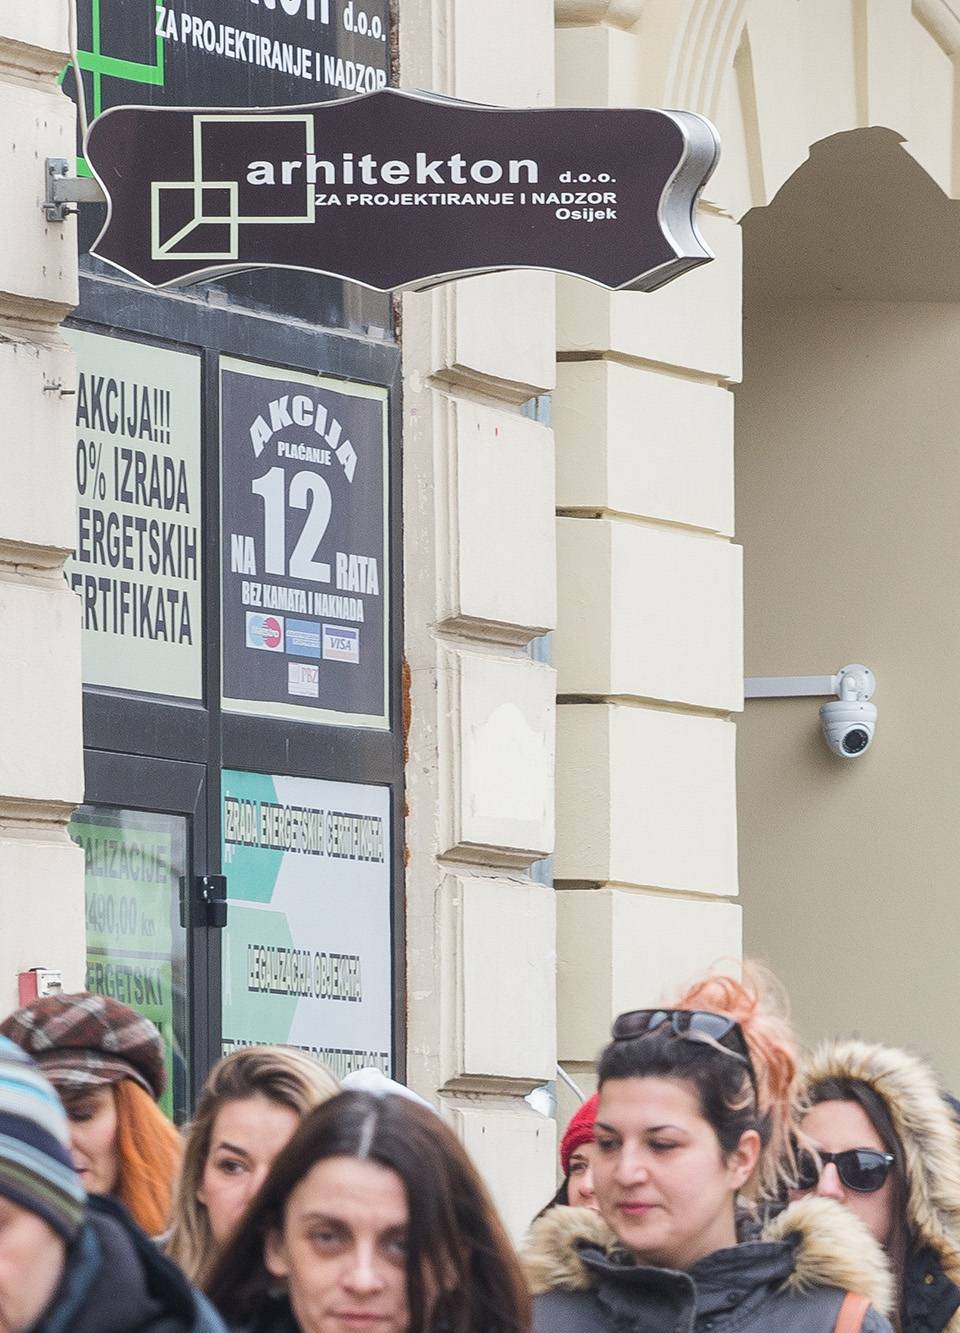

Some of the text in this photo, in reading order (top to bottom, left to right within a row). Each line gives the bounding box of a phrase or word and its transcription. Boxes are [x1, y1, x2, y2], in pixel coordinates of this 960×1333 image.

[343, 1, 387, 42] d.o.o.
[155, 5, 179, 42] ZA
[181, 13, 313, 80] PROJEKTIRANJE
[315, 52, 321, 82] I
[324, 54, 387, 94] NADZOR
[246, 152, 617, 186] arhitekton d.o.o.
[314, 192, 618, 206] ZA PROJEKTIRANJE I NADZOR
[555, 208, 618, 223] Osijek
[76, 372, 171, 445] AKCIJA!!!
[249, 394, 358, 484] AKCIJA
[277, 441, 332, 466] PLAĆANJE
[114, 446, 190, 514] IZRADA
[72, 506, 197, 581] ERGETSKIH
[230, 466, 380, 596] NA 12 RATA
[63, 570, 193, 646] RTIFIKATA
[241, 580, 262, 607] BEZ
[262, 583, 308, 614] KAMATA
[308, 591, 313, 615] I
[329, 637, 352, 651] VISA
[71, 835, 168, 884] ALIZACIJE
